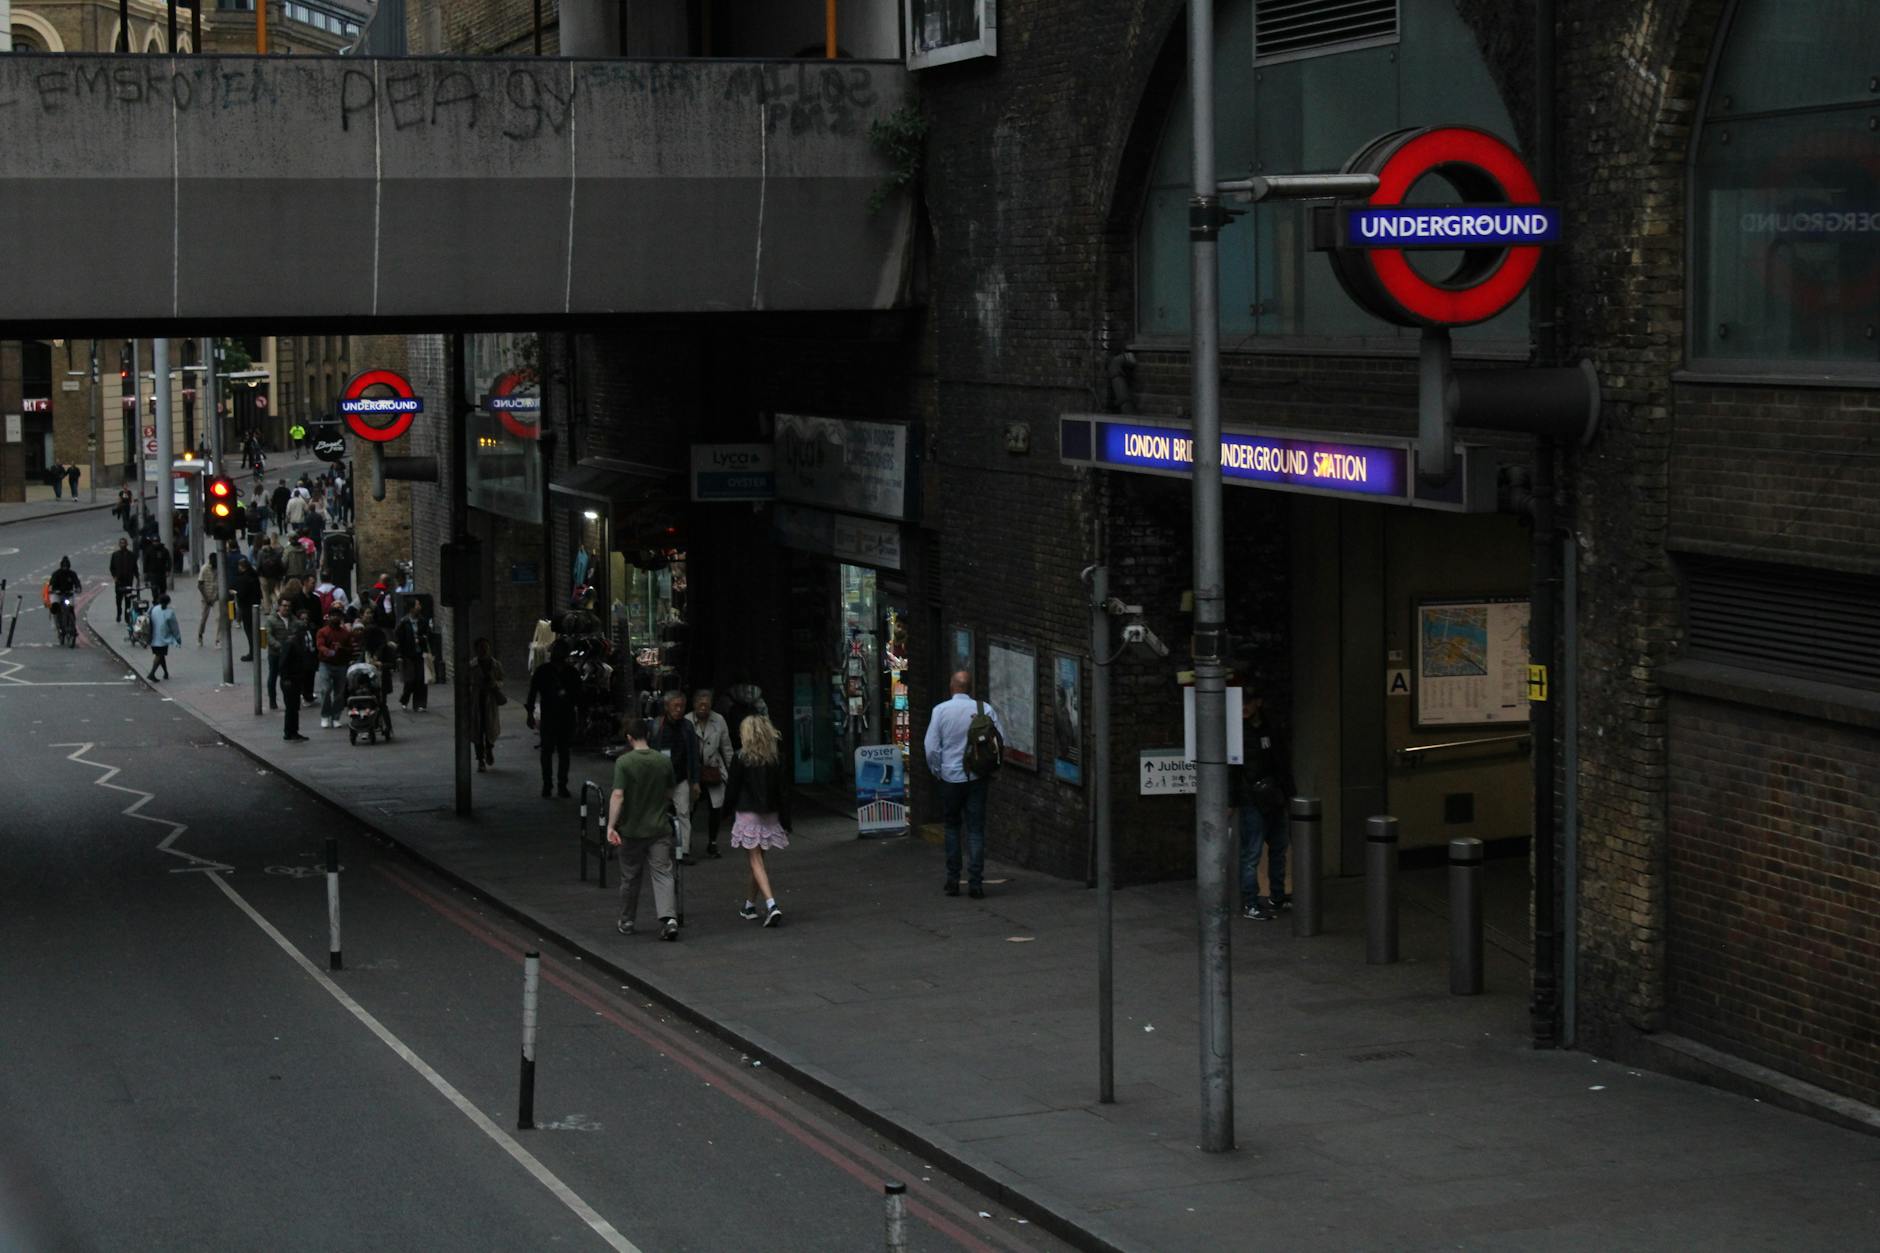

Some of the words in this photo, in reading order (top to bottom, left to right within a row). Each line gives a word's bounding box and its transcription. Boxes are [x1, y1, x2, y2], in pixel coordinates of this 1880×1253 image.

[1360, 214, 1548, 237] UNDERGROUND
[342, 400, 418, 411] UNDERGROUND
[712, 450, 749, 466] Lyca
[1124, 433, 1170, 461] LONDON
[1172, 437, 1194, 463] BRI
[1312, 455, 1367, 482] STATION
[727, 477, 767, 488] OYSTER
[1391, 672, 1408, 692] A
[860, 747, 894, 759] oyster
